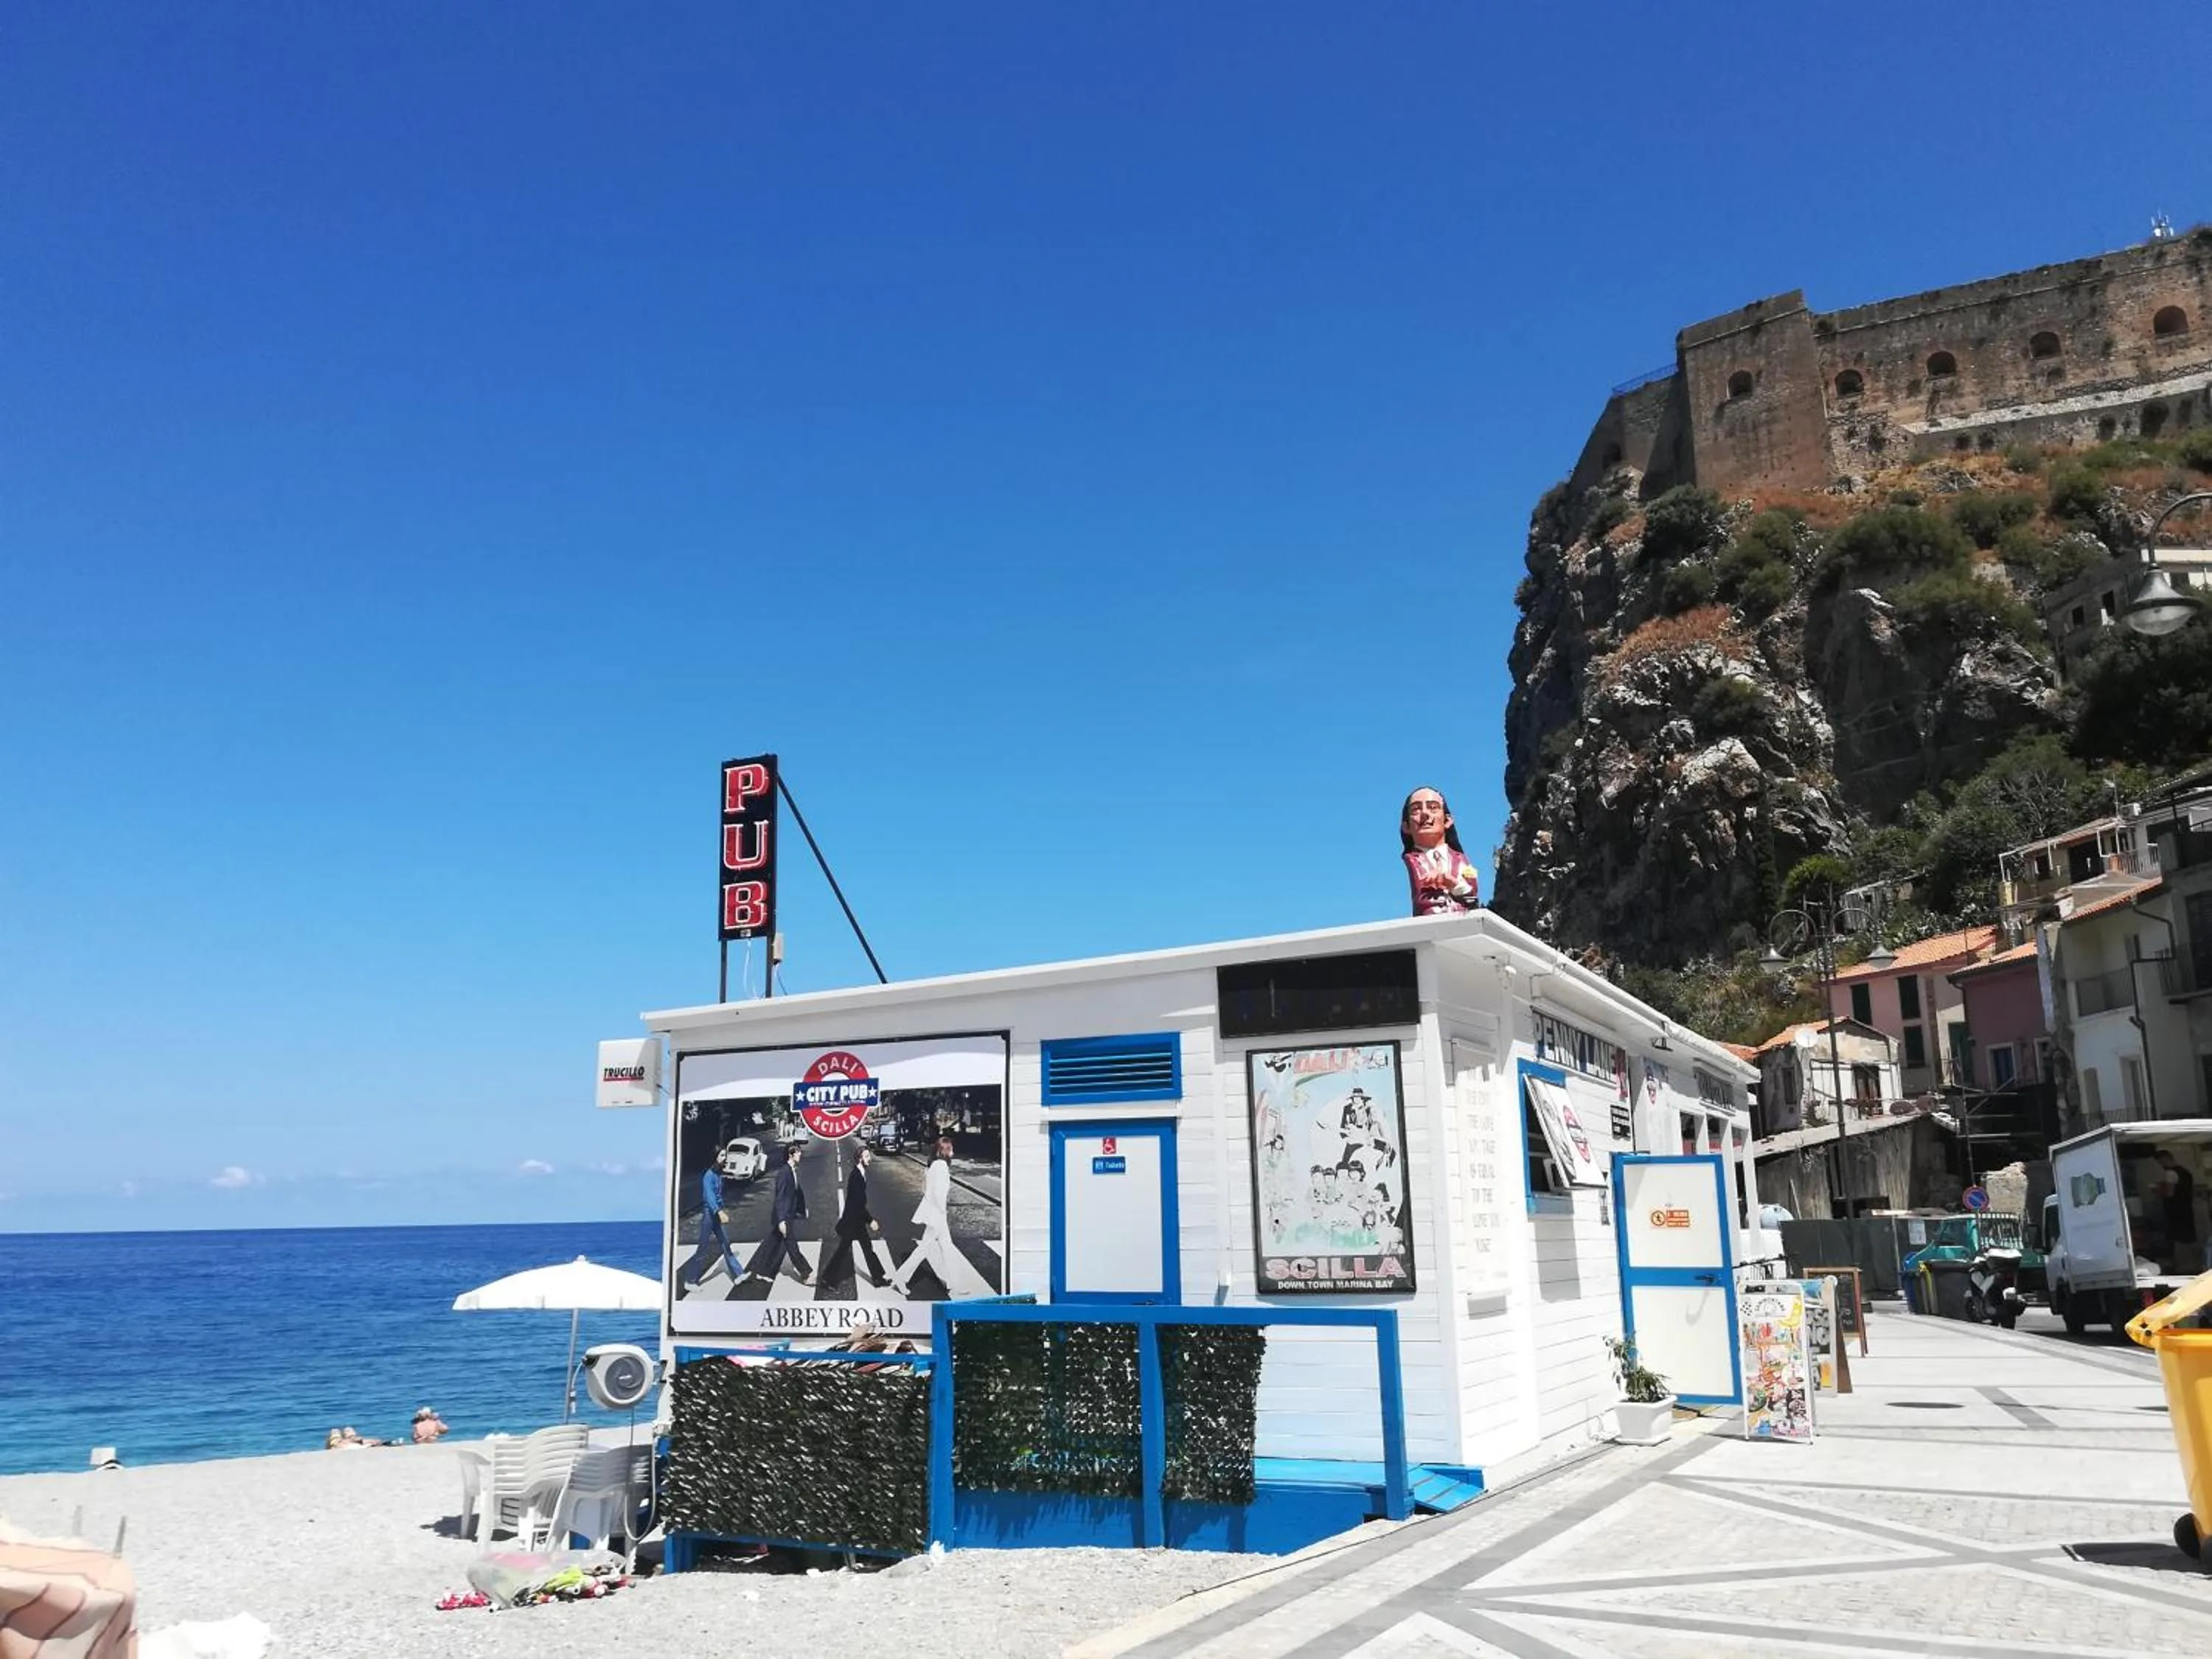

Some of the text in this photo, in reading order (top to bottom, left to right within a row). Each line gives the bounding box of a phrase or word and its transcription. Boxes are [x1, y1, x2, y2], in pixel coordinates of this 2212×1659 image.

[723, 762, 769, 931] PUB
[1534, 1011, 1582, 1071] PENNY
[603, 1065, 645, 1078] TRUCILLO
[806, 1083, 868, 1103] CITY PUB
[813, 1113, 859, 1133] SCILLA
[1265, 1256, 1407, 1280] SCILLA
[1278, 1279, 1394, 1290] DOWN TOWN MARINA BAY
[760, 1307, 904, 1328] ABBEY ROAD
